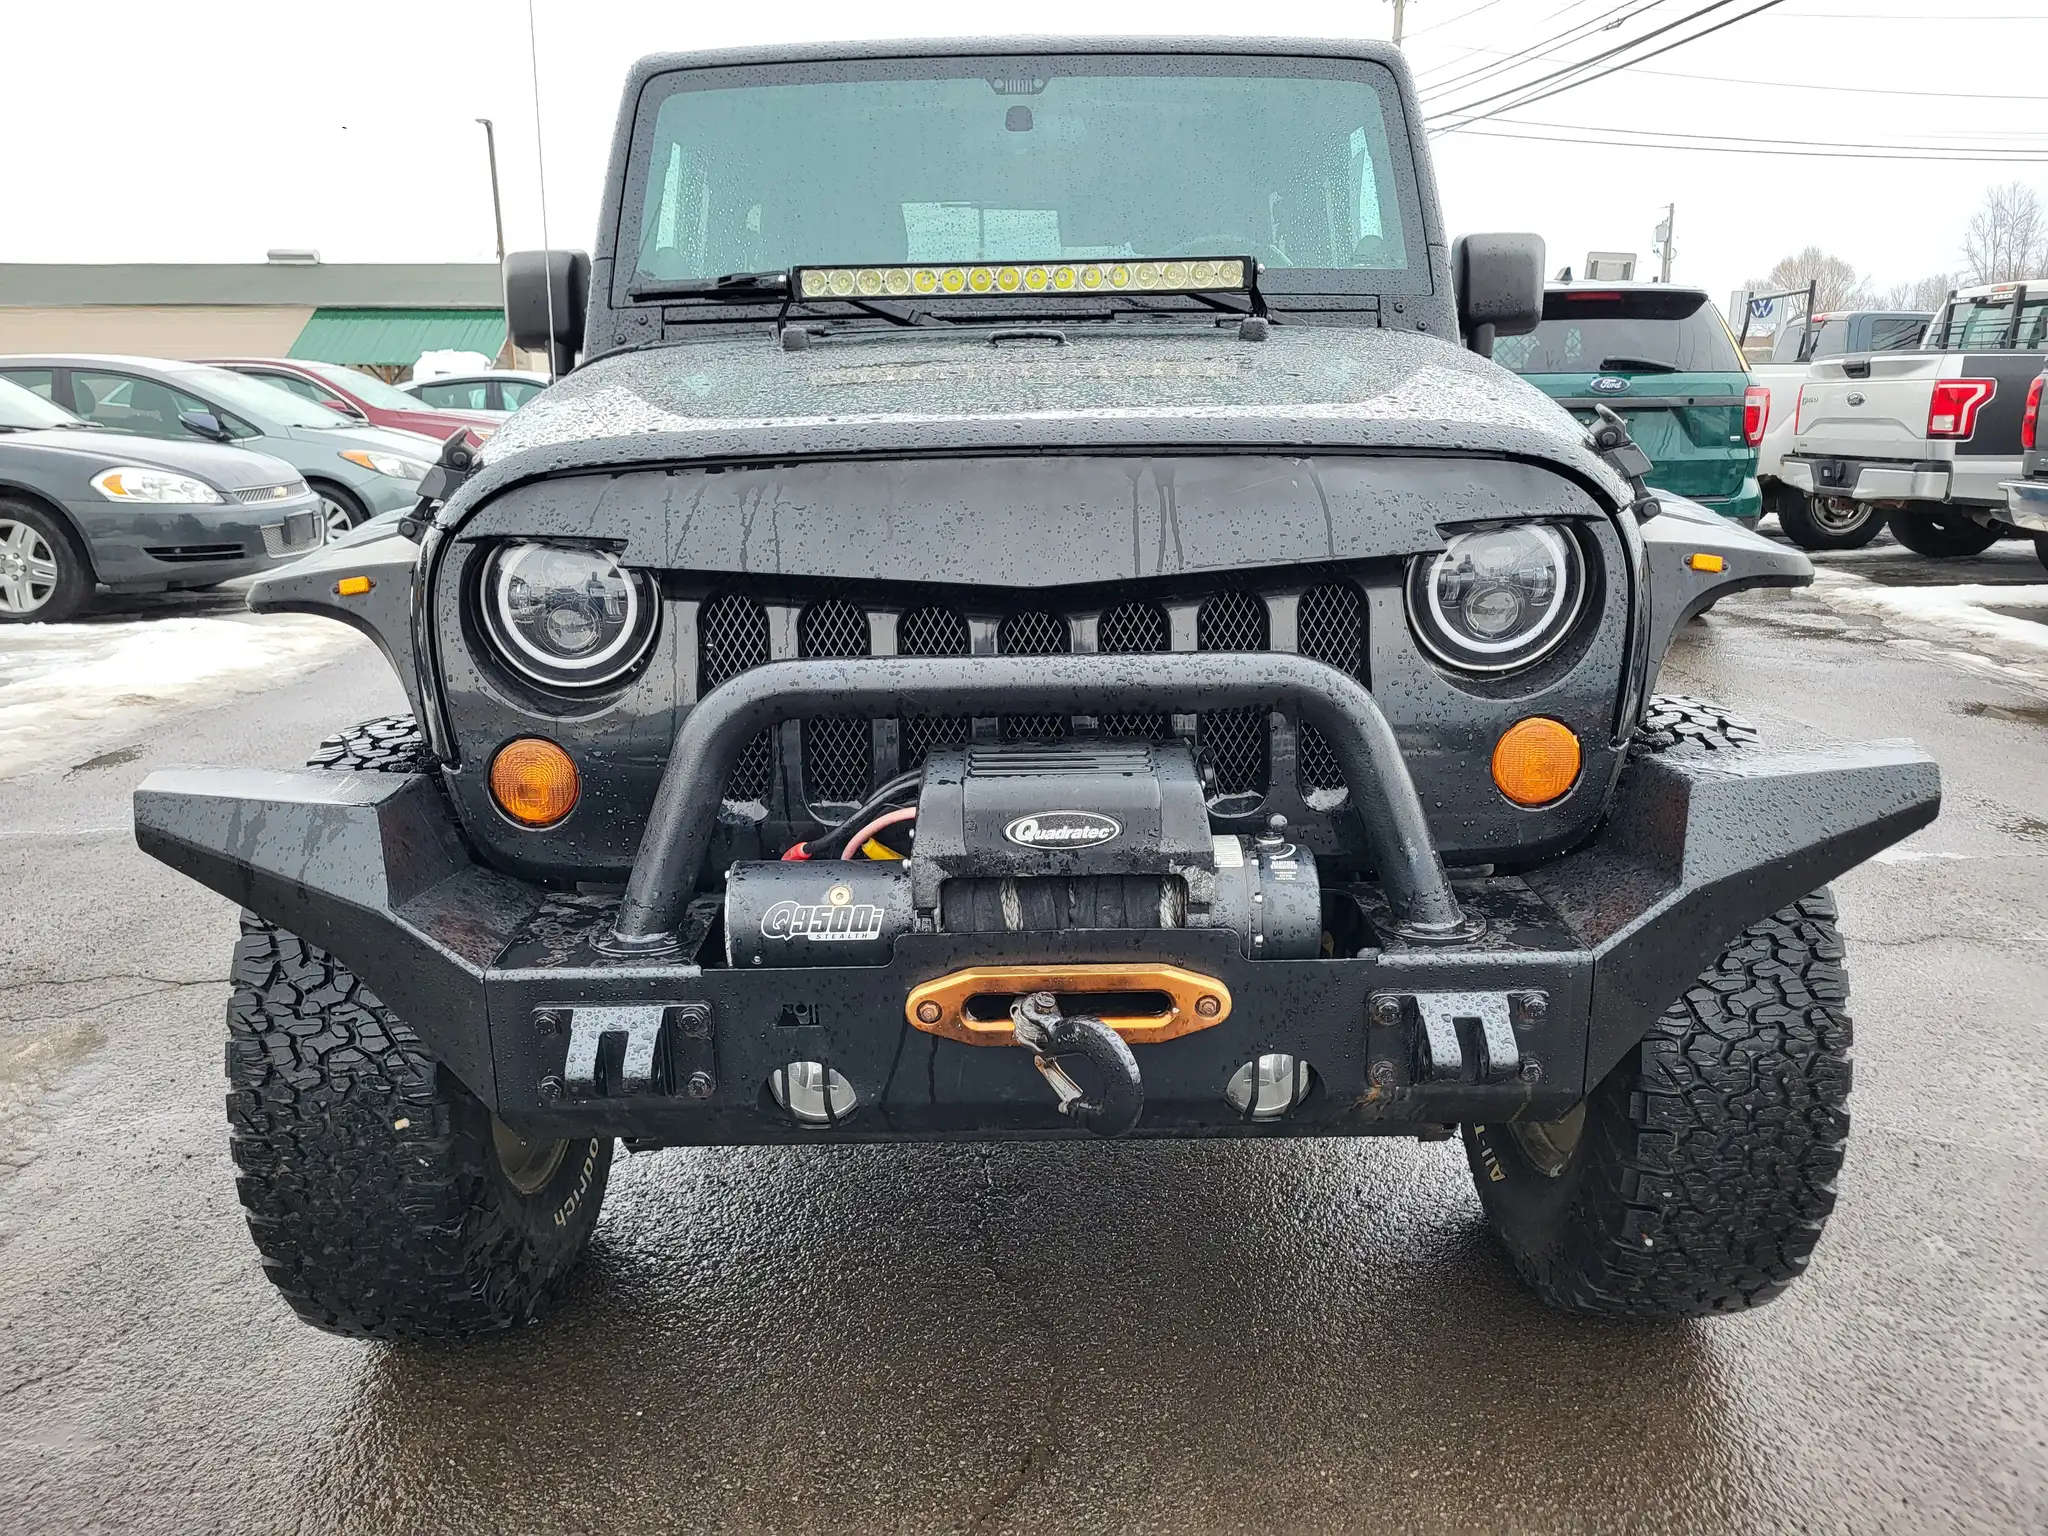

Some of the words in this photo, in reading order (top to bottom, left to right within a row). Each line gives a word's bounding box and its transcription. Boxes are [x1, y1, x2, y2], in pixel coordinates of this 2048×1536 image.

[1600, 378, 1622, 389] Ford
[1015, 819, 1111, 842] Quadratec
[761, 900, 884, 941] Q9500i
[553, 1138, 599, 1227] odrich
